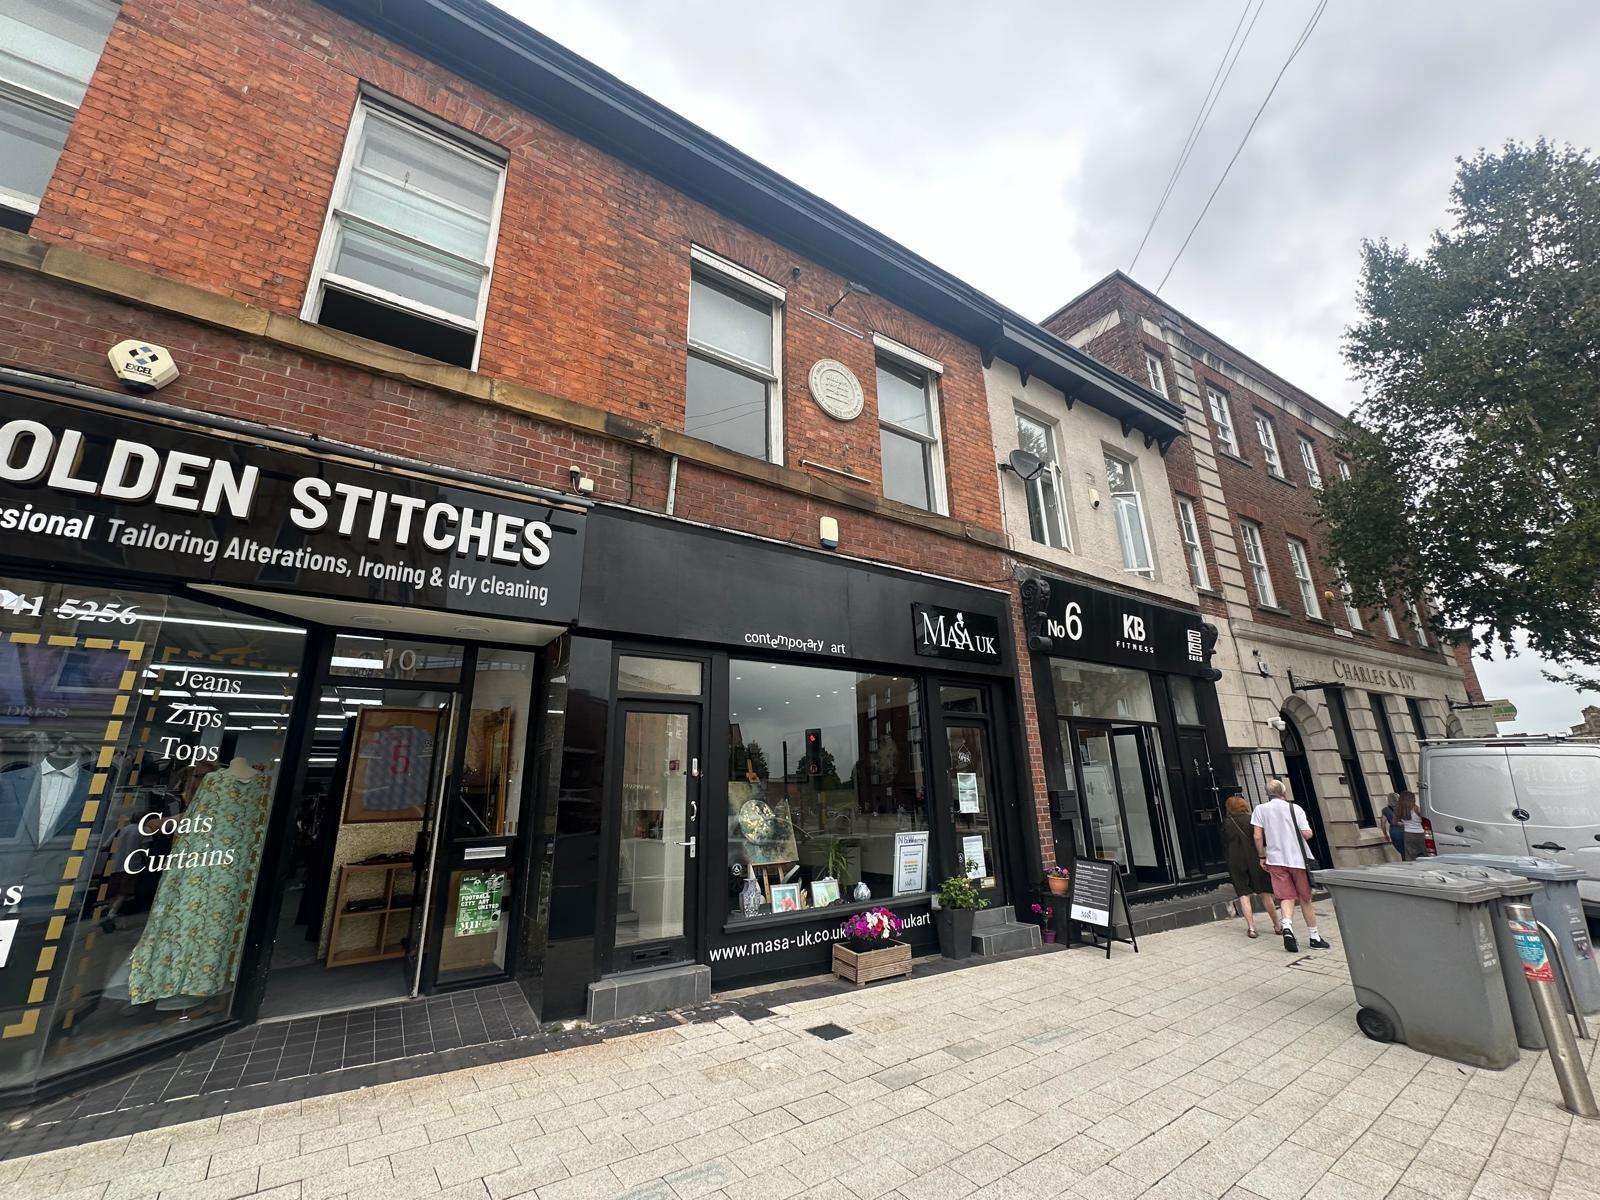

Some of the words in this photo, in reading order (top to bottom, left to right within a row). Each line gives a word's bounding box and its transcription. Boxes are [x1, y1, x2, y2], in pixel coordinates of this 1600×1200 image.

[125, 362, 153, 375] EXCEL
[0, 419, 259, 520] OLDEN
[290, 476, 553, 569] STITCHES
[0, 503, 95, 540] sional
[106, 517, 219, 563] Tailoring
[223, 536, 352, 578] Alterations,
[357, 555, 426, 589] Ironing
[429, 566, 444, 587] &
[449, 570, 477, 596] dry
[480, 575, 549, 606] cleaning
[57, 598, 141, 625] 5256
[744, 631, 824, 652] contemporary
[830, 642, 846, 655] art
[920, 611, 975, 652] MASA
[974, 635, 998, 655] UK
[1122, 613, 1146, 642] KB
[384, 648, 416, 671] 10
[1115, 640, 1155, 654] FITNESS
[175, 667, 242, 695] Jeans
[1332, 659, 1387, 687] CHARLES
[1387, 670, 1399, 689] &
[1398, 671, 1416, 690] IVY
[165, 702, 223, 733] Zips
[160, 736, 219, 767] Tops
[137, 811, 214, 837] Coats
[123, 843, 235, 875] Curtains
[709, 928, 846, 962] www.masa-uk.co.uk
